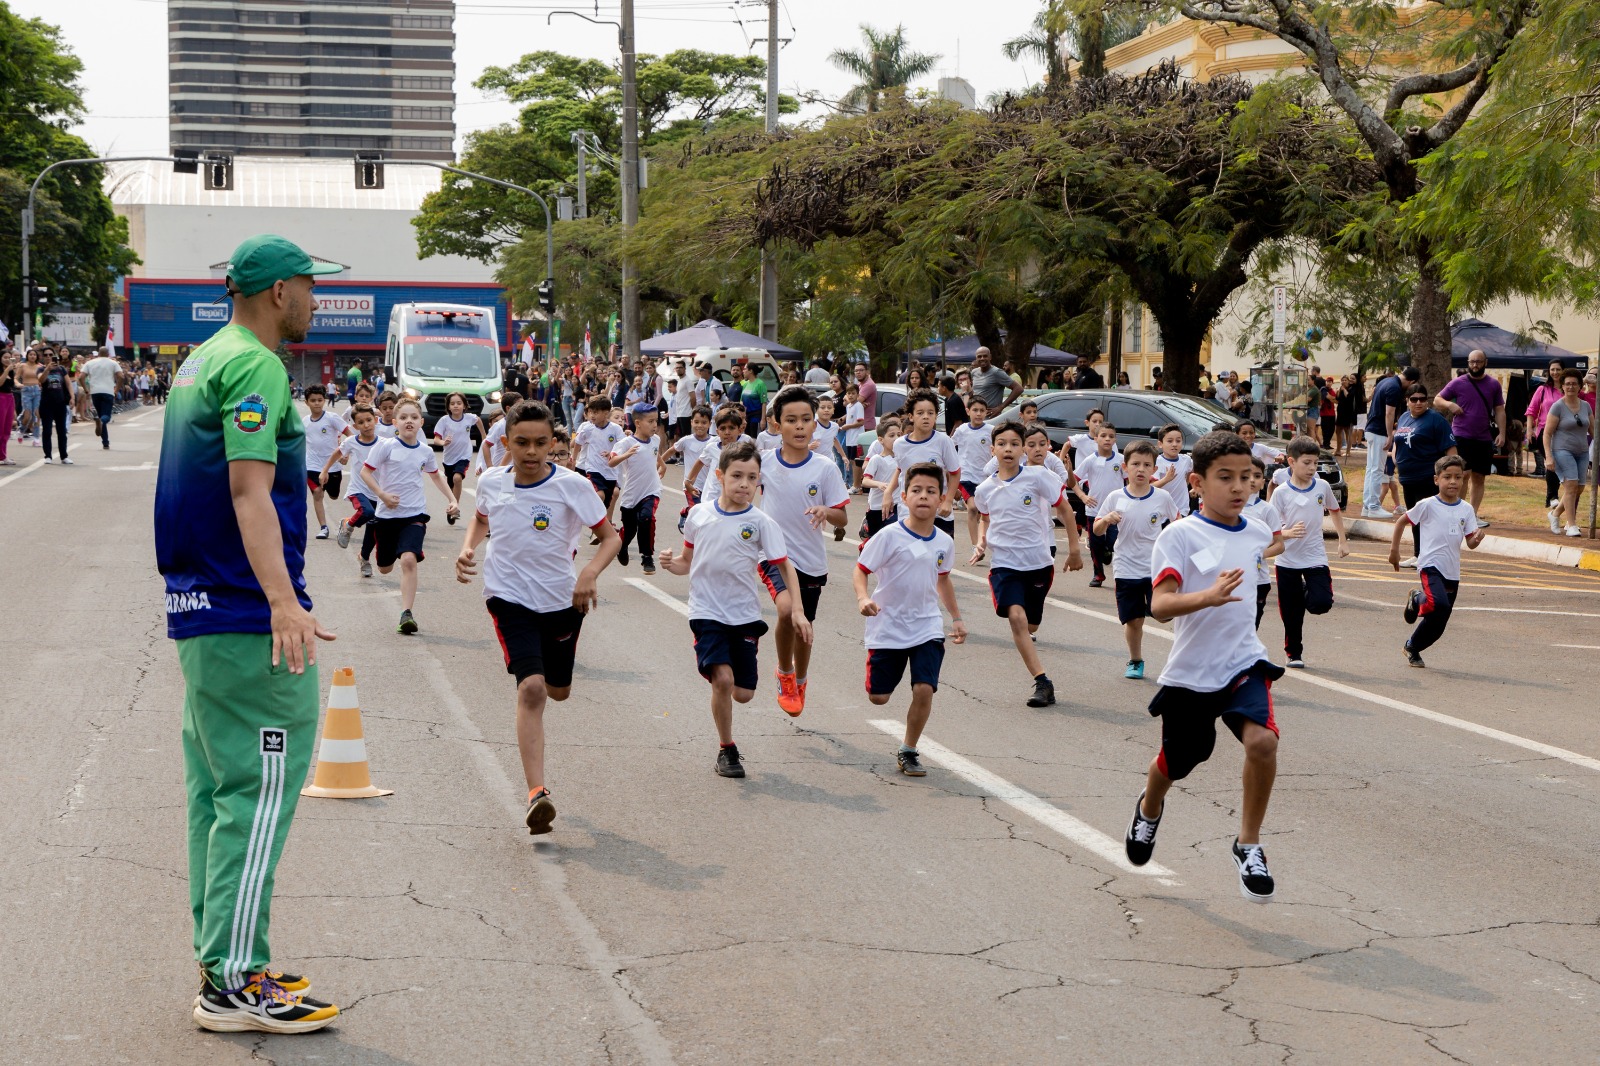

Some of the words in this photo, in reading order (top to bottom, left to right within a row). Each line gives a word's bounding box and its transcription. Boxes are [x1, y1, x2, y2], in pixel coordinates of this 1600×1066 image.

[320, 299, 371, 310] TUDO
[198, 308, 225, 318] Report
[321, 318, 374, 327] PAPELARIA
[531, 504, 552, 512] ESCOLA
